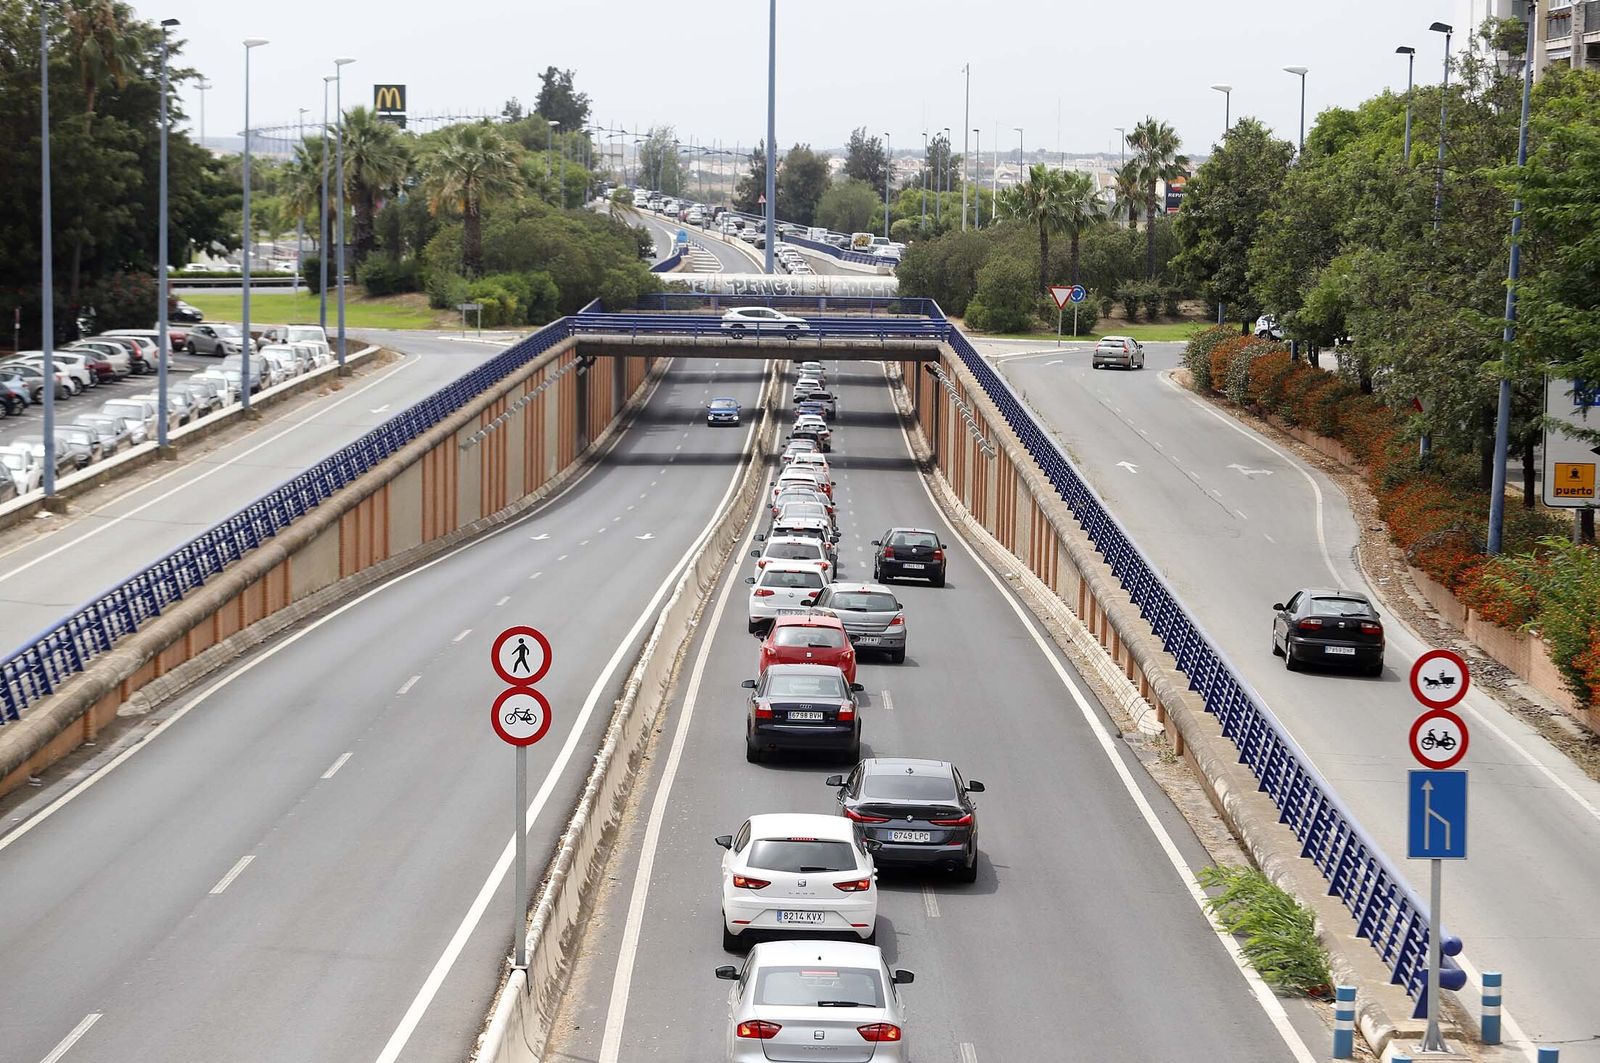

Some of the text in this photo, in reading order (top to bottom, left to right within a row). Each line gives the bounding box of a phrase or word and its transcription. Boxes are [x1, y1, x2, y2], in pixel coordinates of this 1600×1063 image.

[1555, 487, 1593, 496] puerto
[893, 831, 929, 841] 6749 LPC
[783, 911, 822, 921] 8214 KVX
